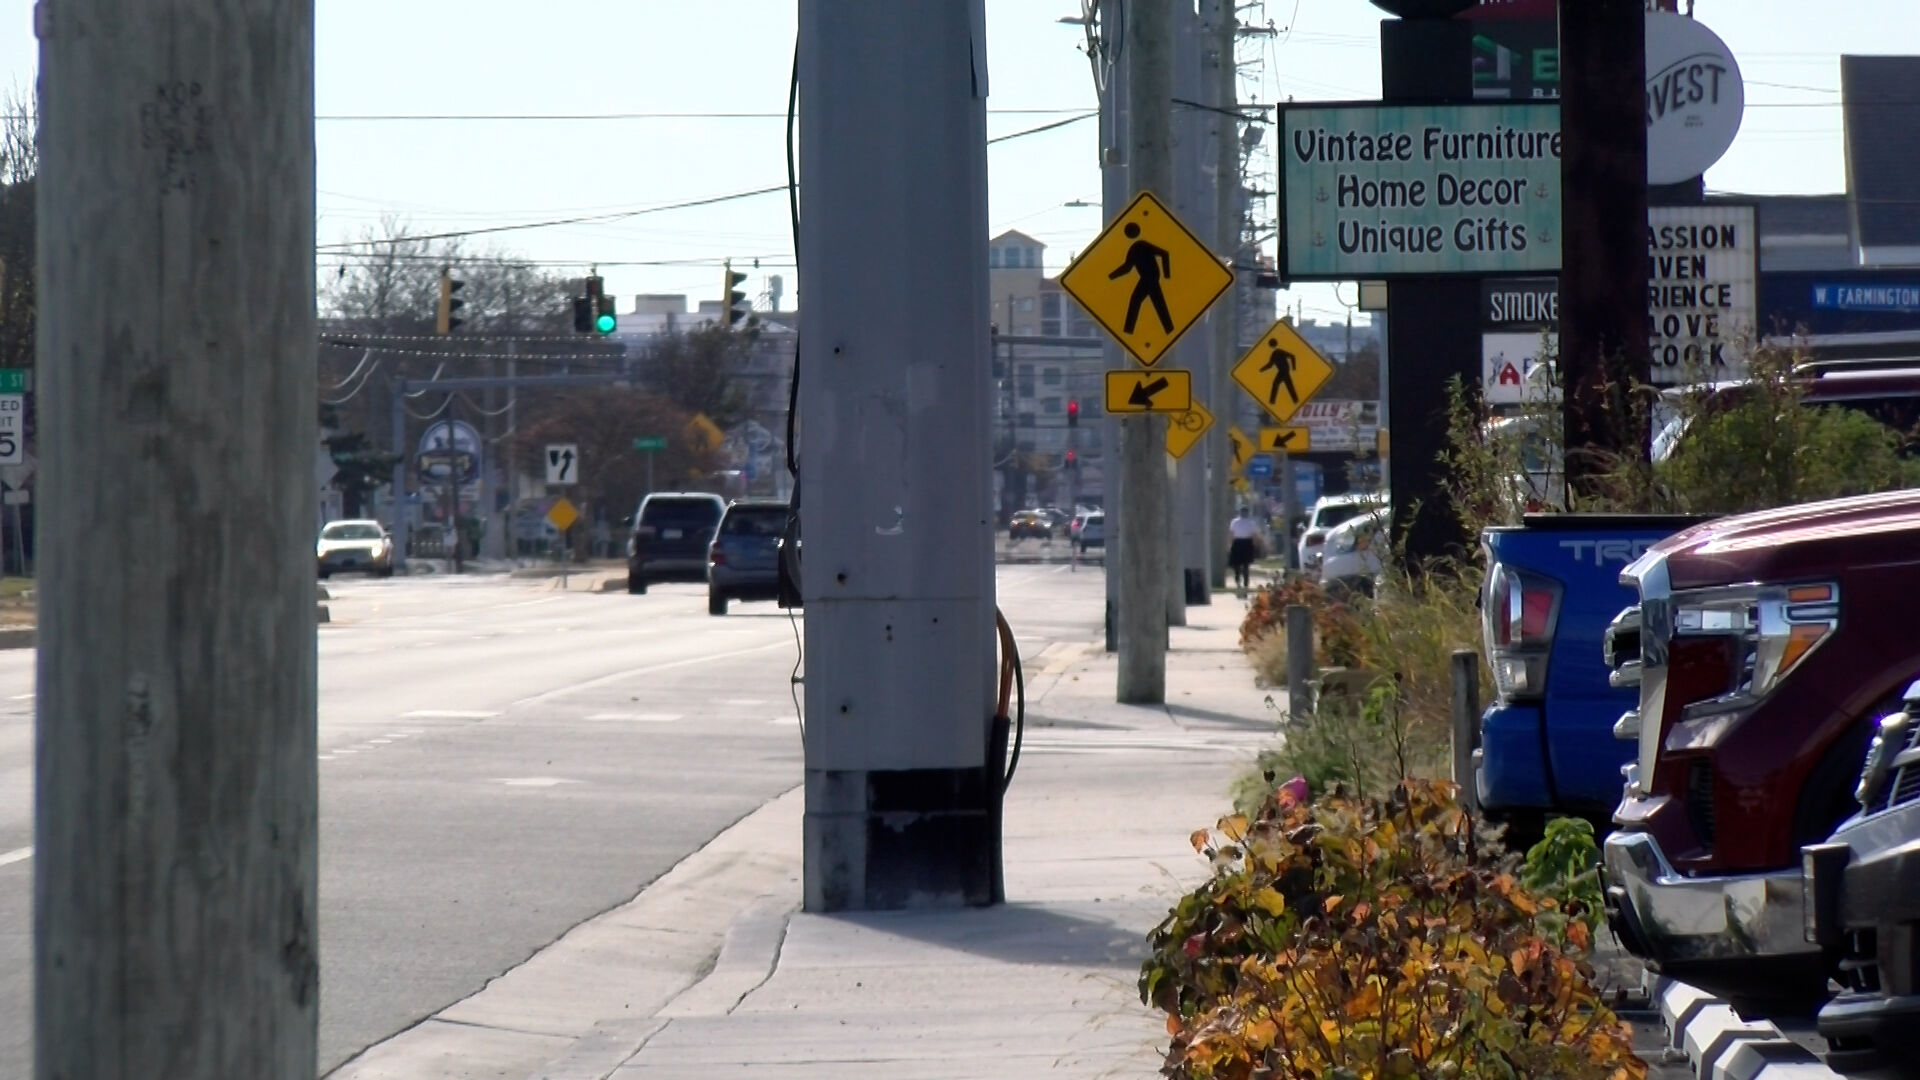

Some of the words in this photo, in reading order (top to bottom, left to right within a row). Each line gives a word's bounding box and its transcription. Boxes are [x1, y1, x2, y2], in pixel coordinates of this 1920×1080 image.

[1294, 129, 1412, 163] Vintage
[1423, 126, 1560, 160] Furniture
[1338, 173, 1426, 207] Home
[1437, 173, 1527, 205] Decor
[1338, 220, 1443, 253] Unique
[1454, 217, 1527, 250] Gifts
[1490, 291, 1559, 321] SMOKE
[1837, 287, 1919, 306] FARMINGTON
